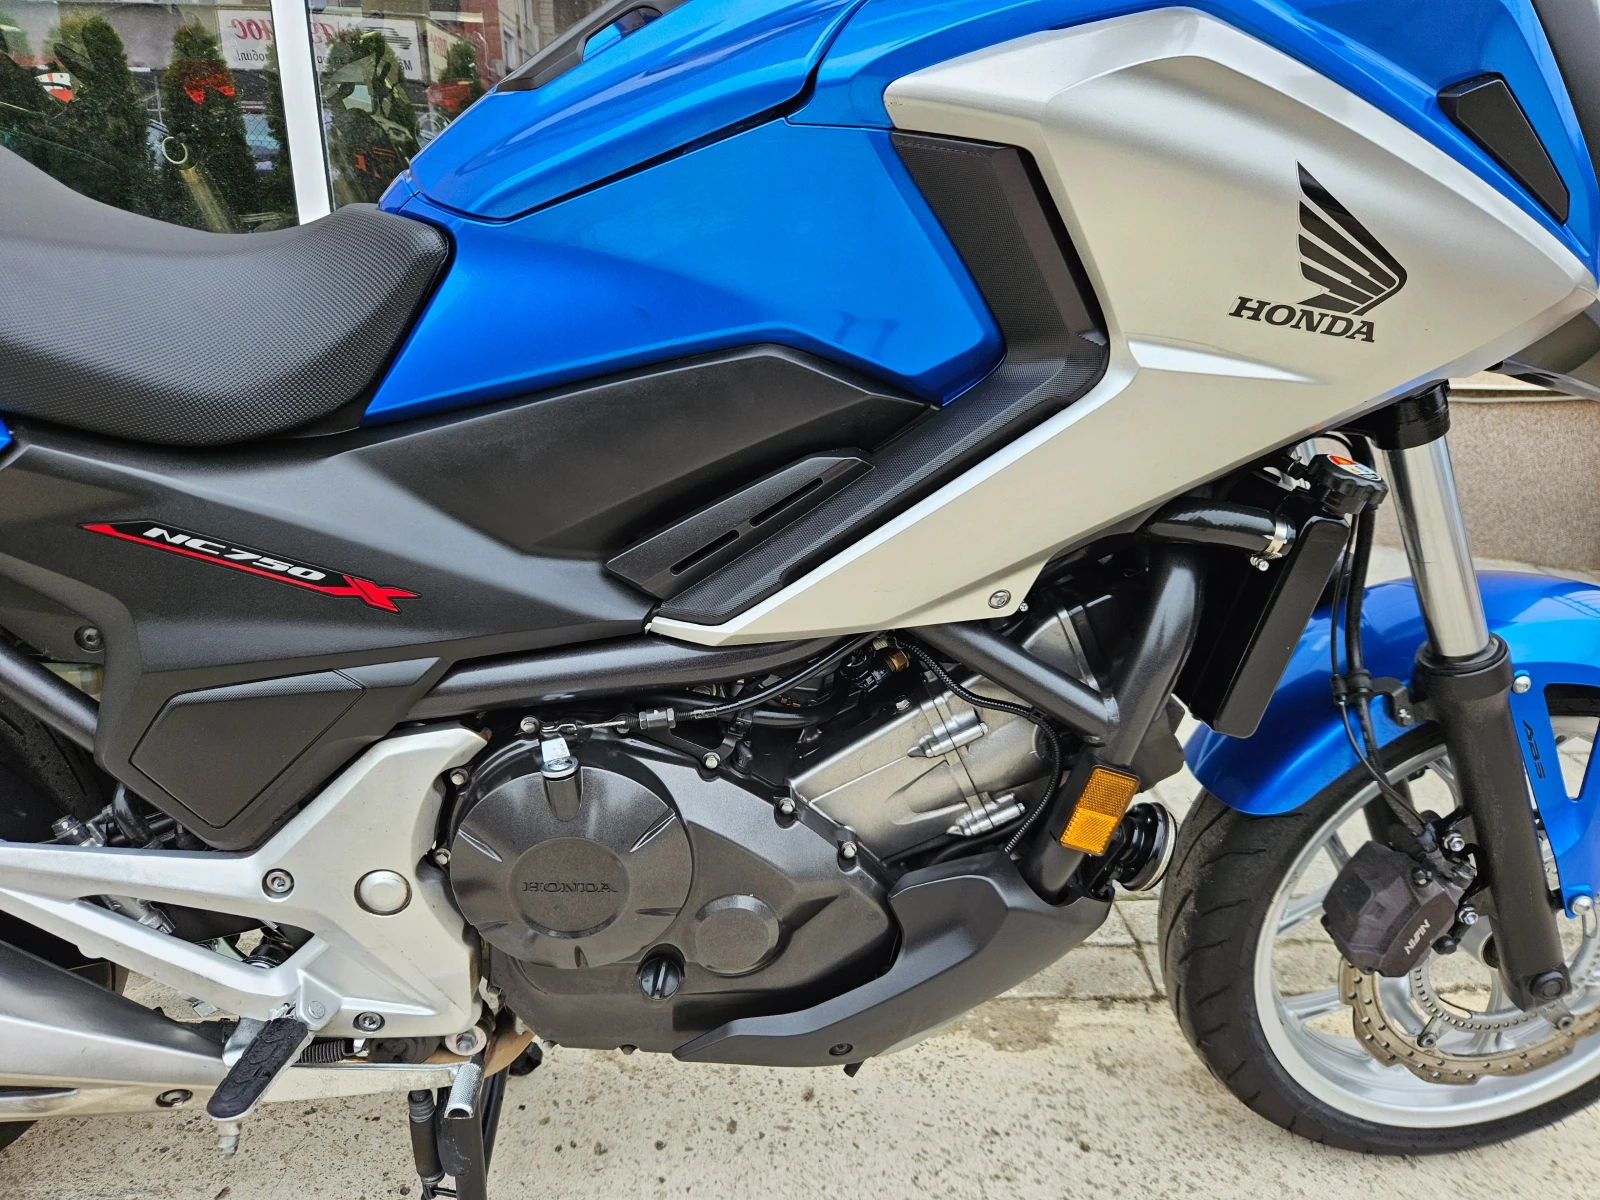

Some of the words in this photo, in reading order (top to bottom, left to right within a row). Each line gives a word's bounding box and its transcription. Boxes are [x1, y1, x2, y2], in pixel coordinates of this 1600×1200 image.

[1228, 295, 1376, 343] HONDA
[1522, 719, 1546, 780] ABS
[522, 880, 618, 894] HONDA
